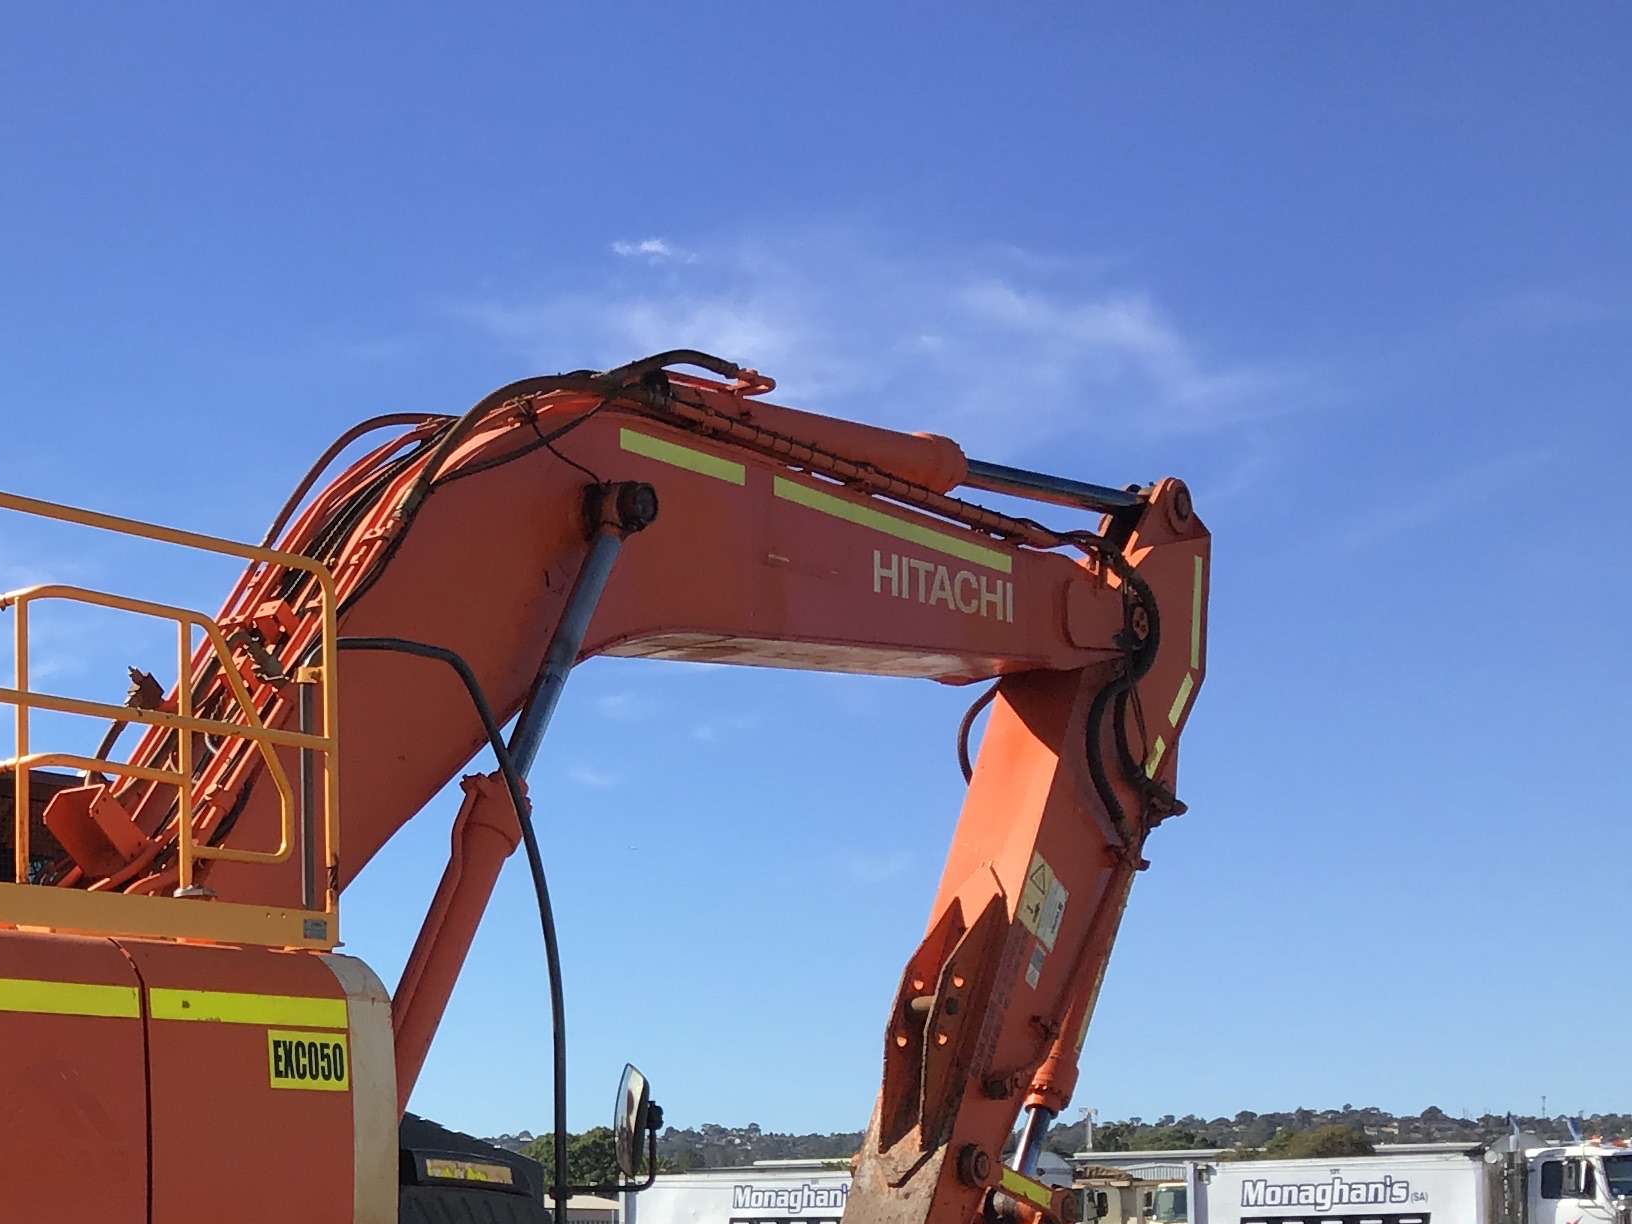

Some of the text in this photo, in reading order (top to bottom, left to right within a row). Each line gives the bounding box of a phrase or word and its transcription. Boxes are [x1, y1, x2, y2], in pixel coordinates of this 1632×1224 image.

[873, 550, 1014, 623] HITACHI
[273, 1040, 344, 1081] EXC050
[733, 1183, 849, 1214] Monaghan'
[1241, 1175, 1410, 1211] Monaghan's
